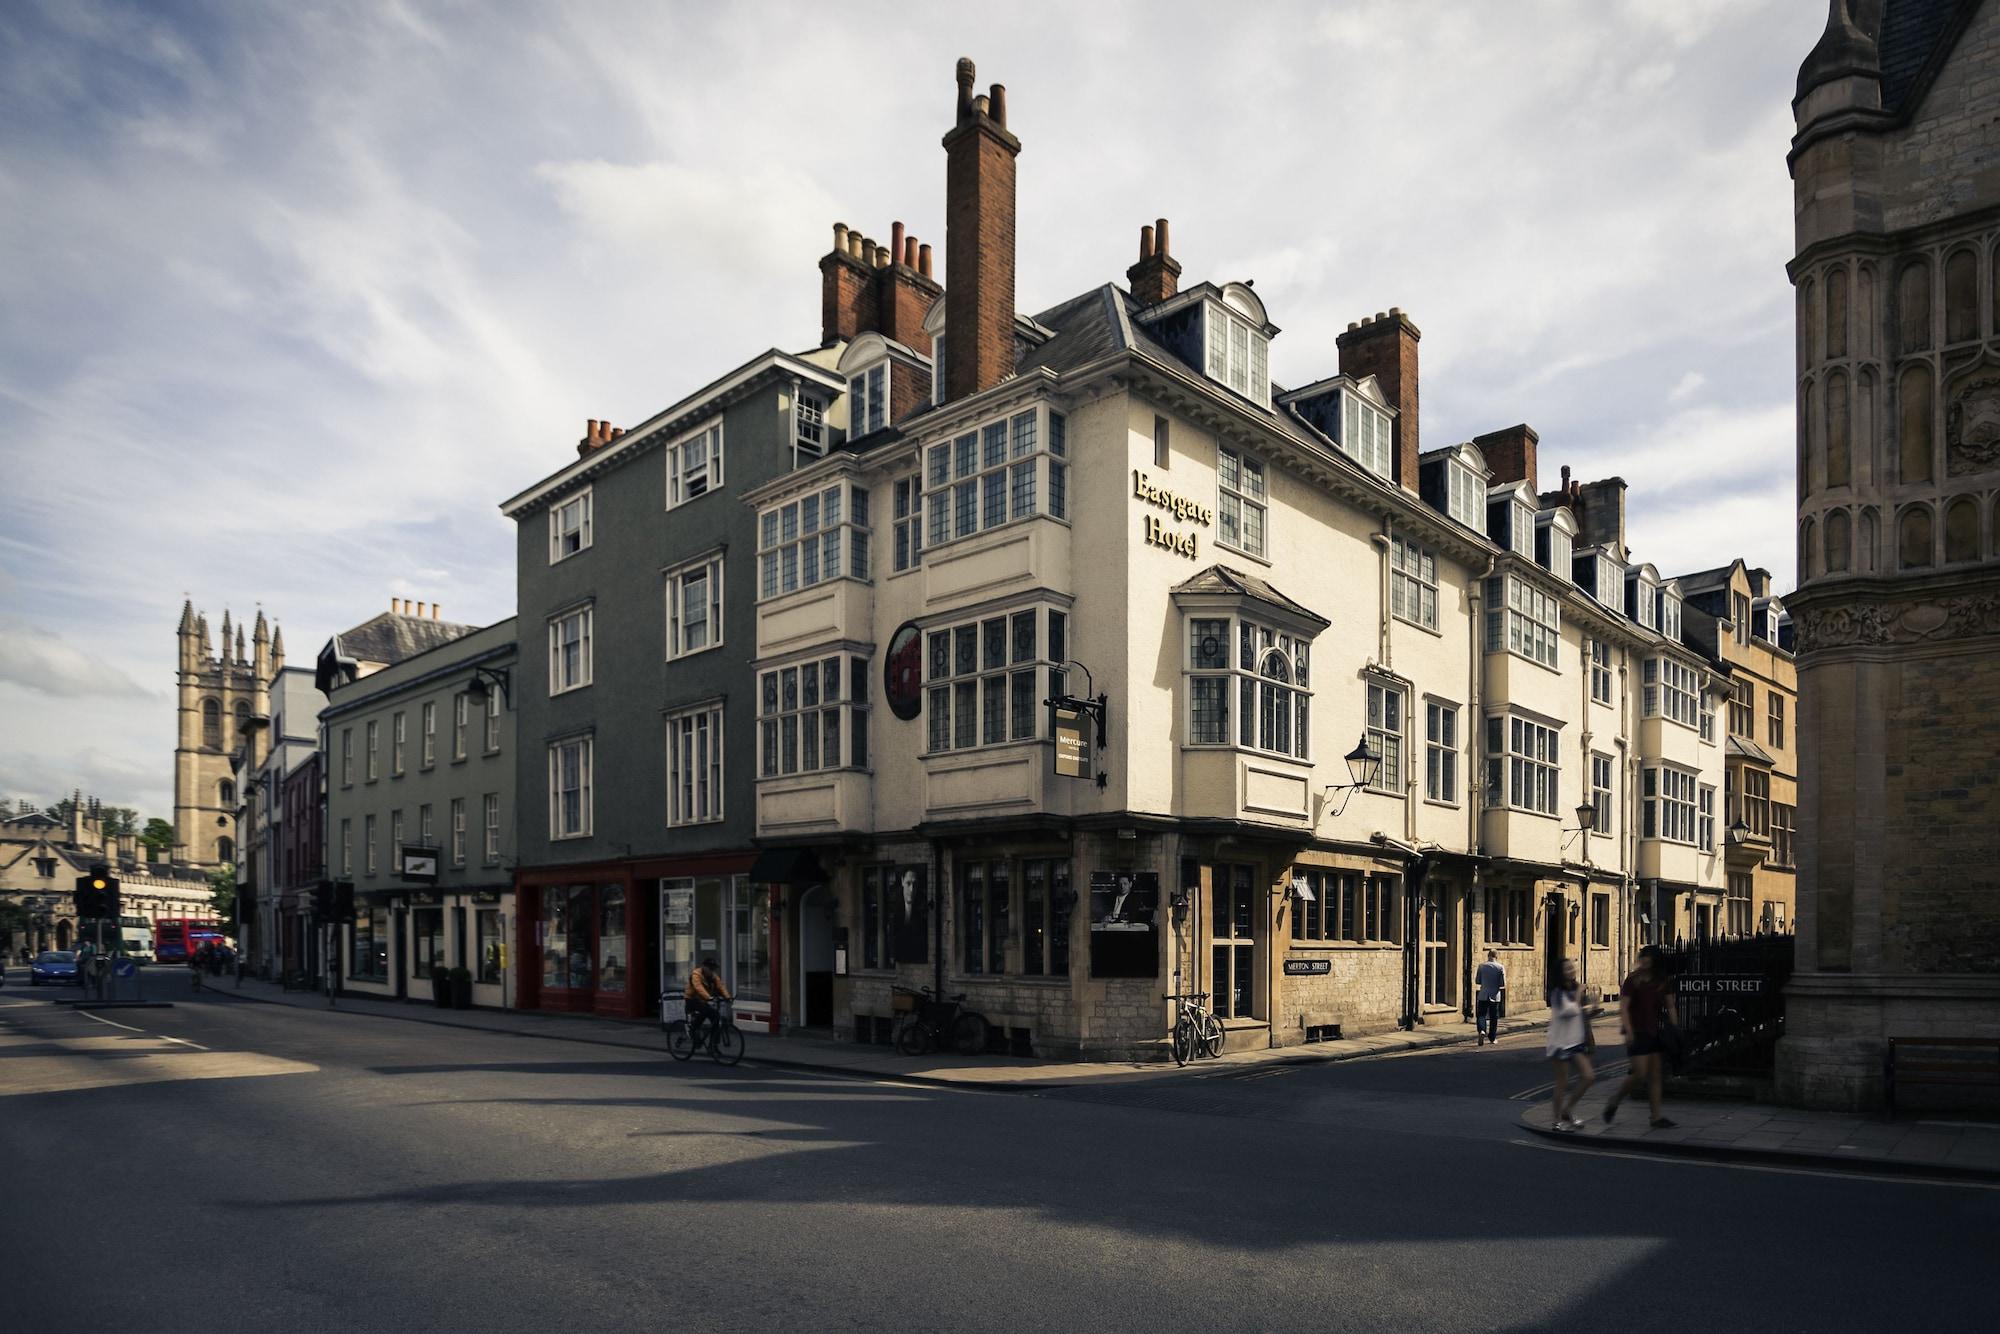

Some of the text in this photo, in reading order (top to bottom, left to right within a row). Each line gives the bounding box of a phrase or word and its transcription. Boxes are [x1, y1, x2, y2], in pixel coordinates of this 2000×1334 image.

[1133, 468, 1213, 526] Eastgate
[1145, 515, 1199, 558] Hotel
[1059, 735, 1088, 747] Mercure
[1288, 962, 1328, 970] MERTON STREET
[1680, 980, 1762, 991] HIGH STREET
